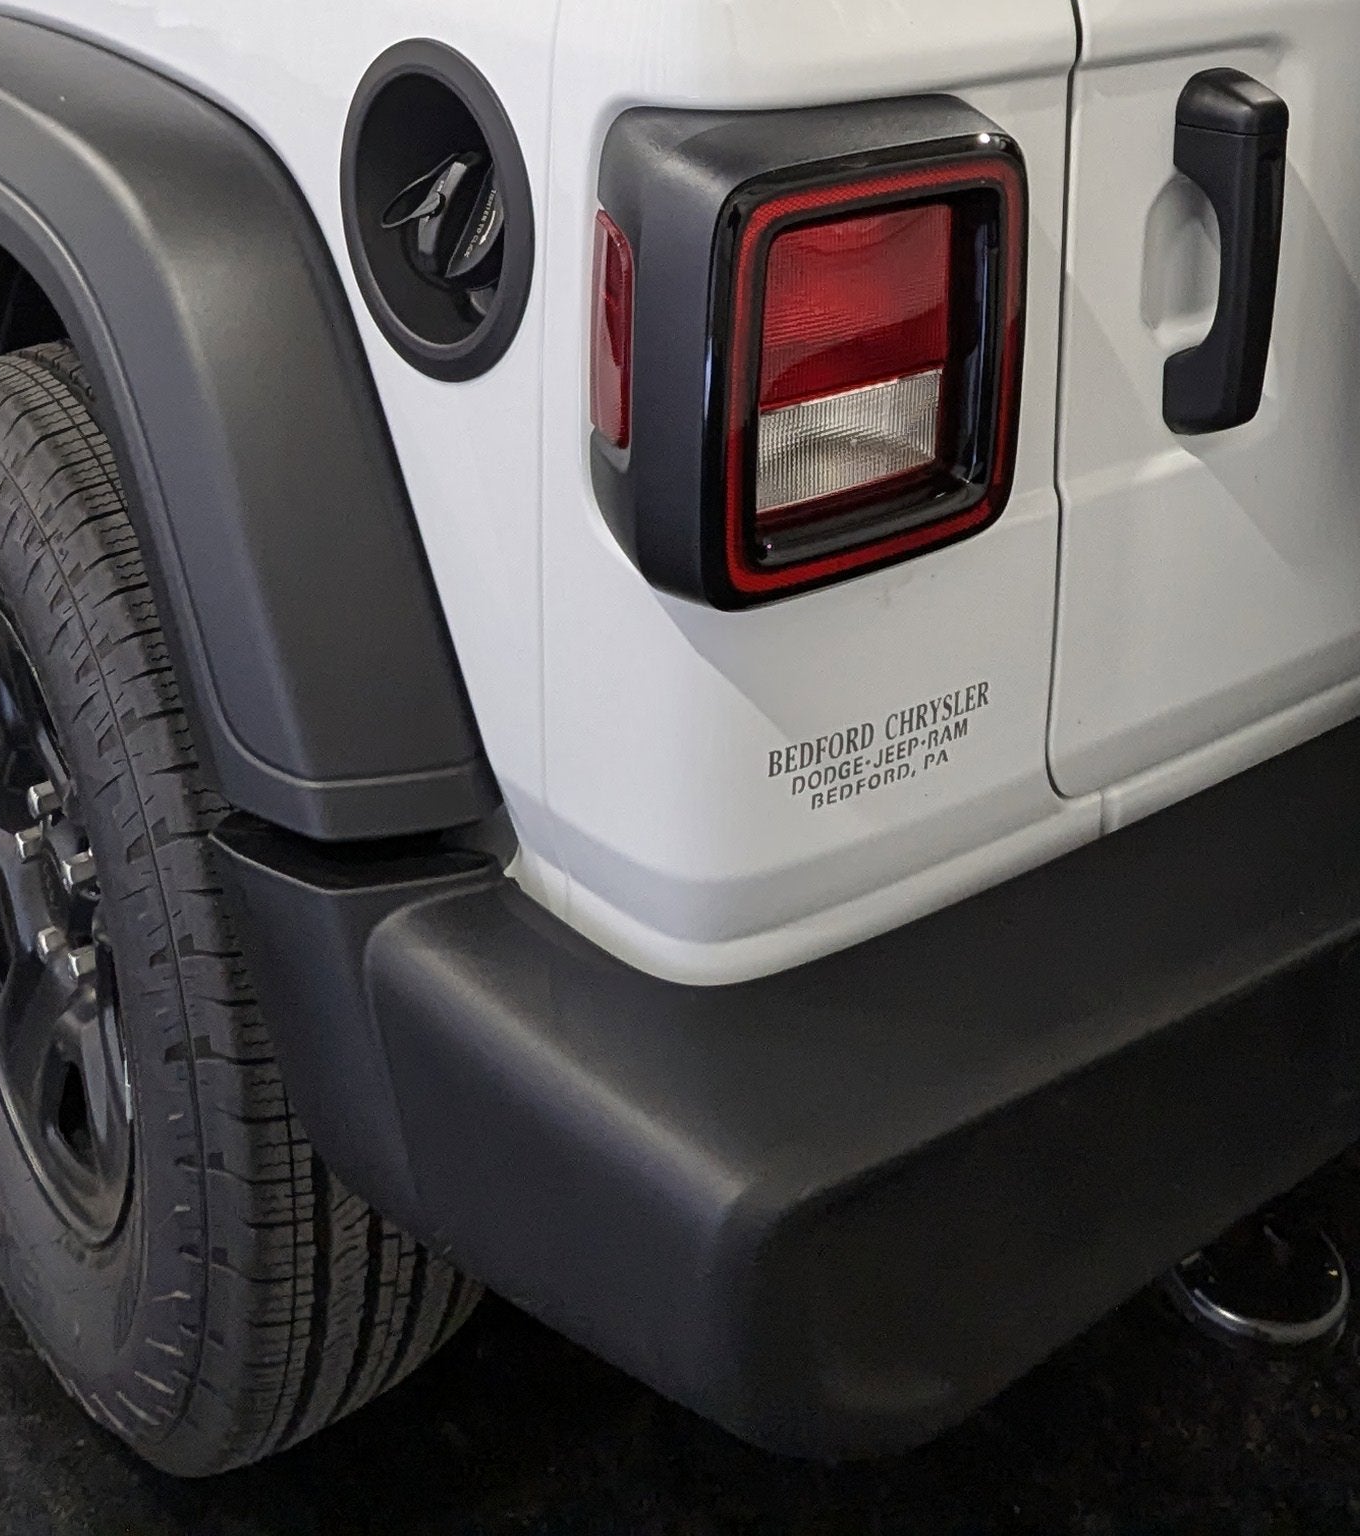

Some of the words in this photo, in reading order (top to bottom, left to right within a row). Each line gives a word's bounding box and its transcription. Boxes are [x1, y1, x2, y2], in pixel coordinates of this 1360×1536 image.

[767, 722, 874, 778] BEDFORD
[885, 681, 989, 740] CHRYSLER
[811, 763, 916, 810] BEDFORD,
[924, 749, 949, 770] PA
